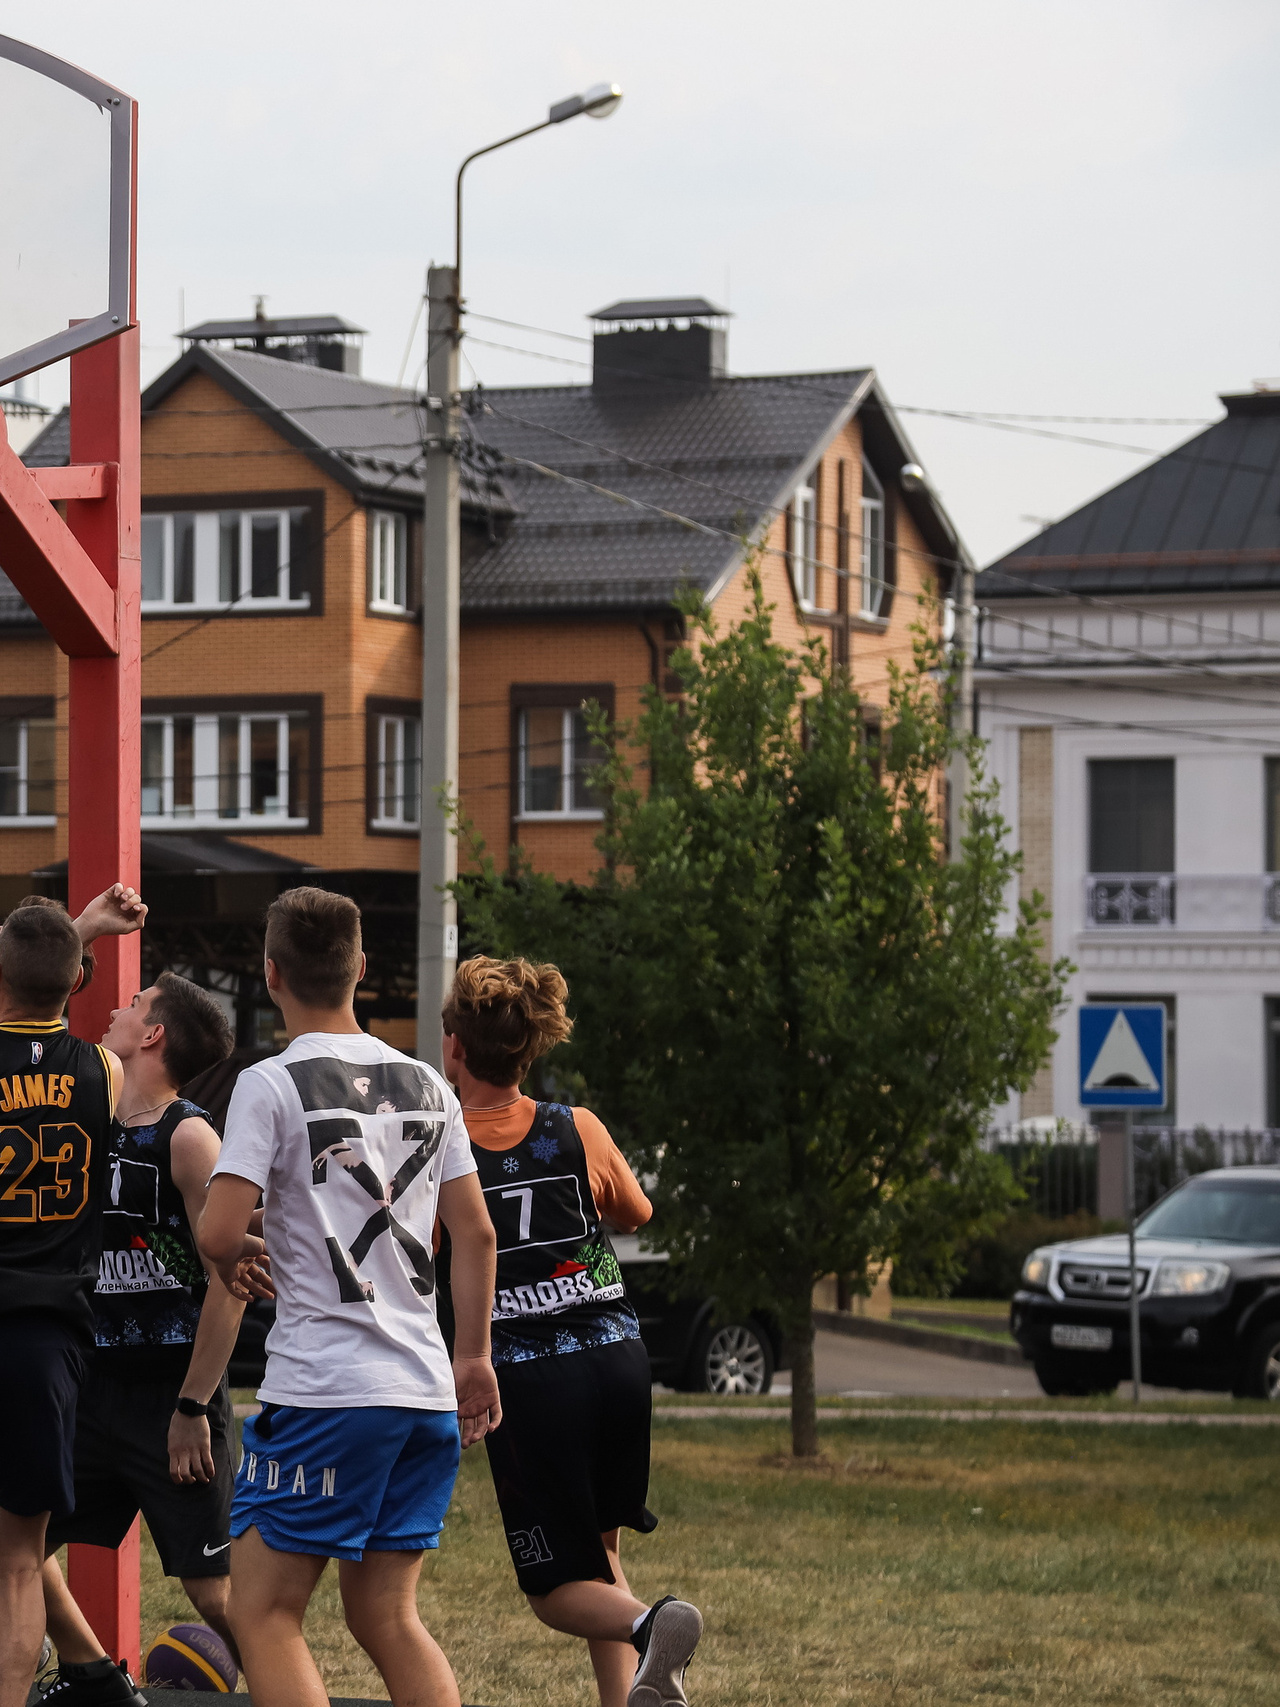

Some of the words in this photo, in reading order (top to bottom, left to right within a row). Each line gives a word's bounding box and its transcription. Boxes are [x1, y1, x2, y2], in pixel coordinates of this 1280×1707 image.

[0, 1073, 76, 1112] JAMES
[501, 1187, 533, 1241] 7
[95, 1280, 148, 1291] ленькая
[238, 1444, 336, 1497] RDAN
[508, 1526, 553, 1567] 21
